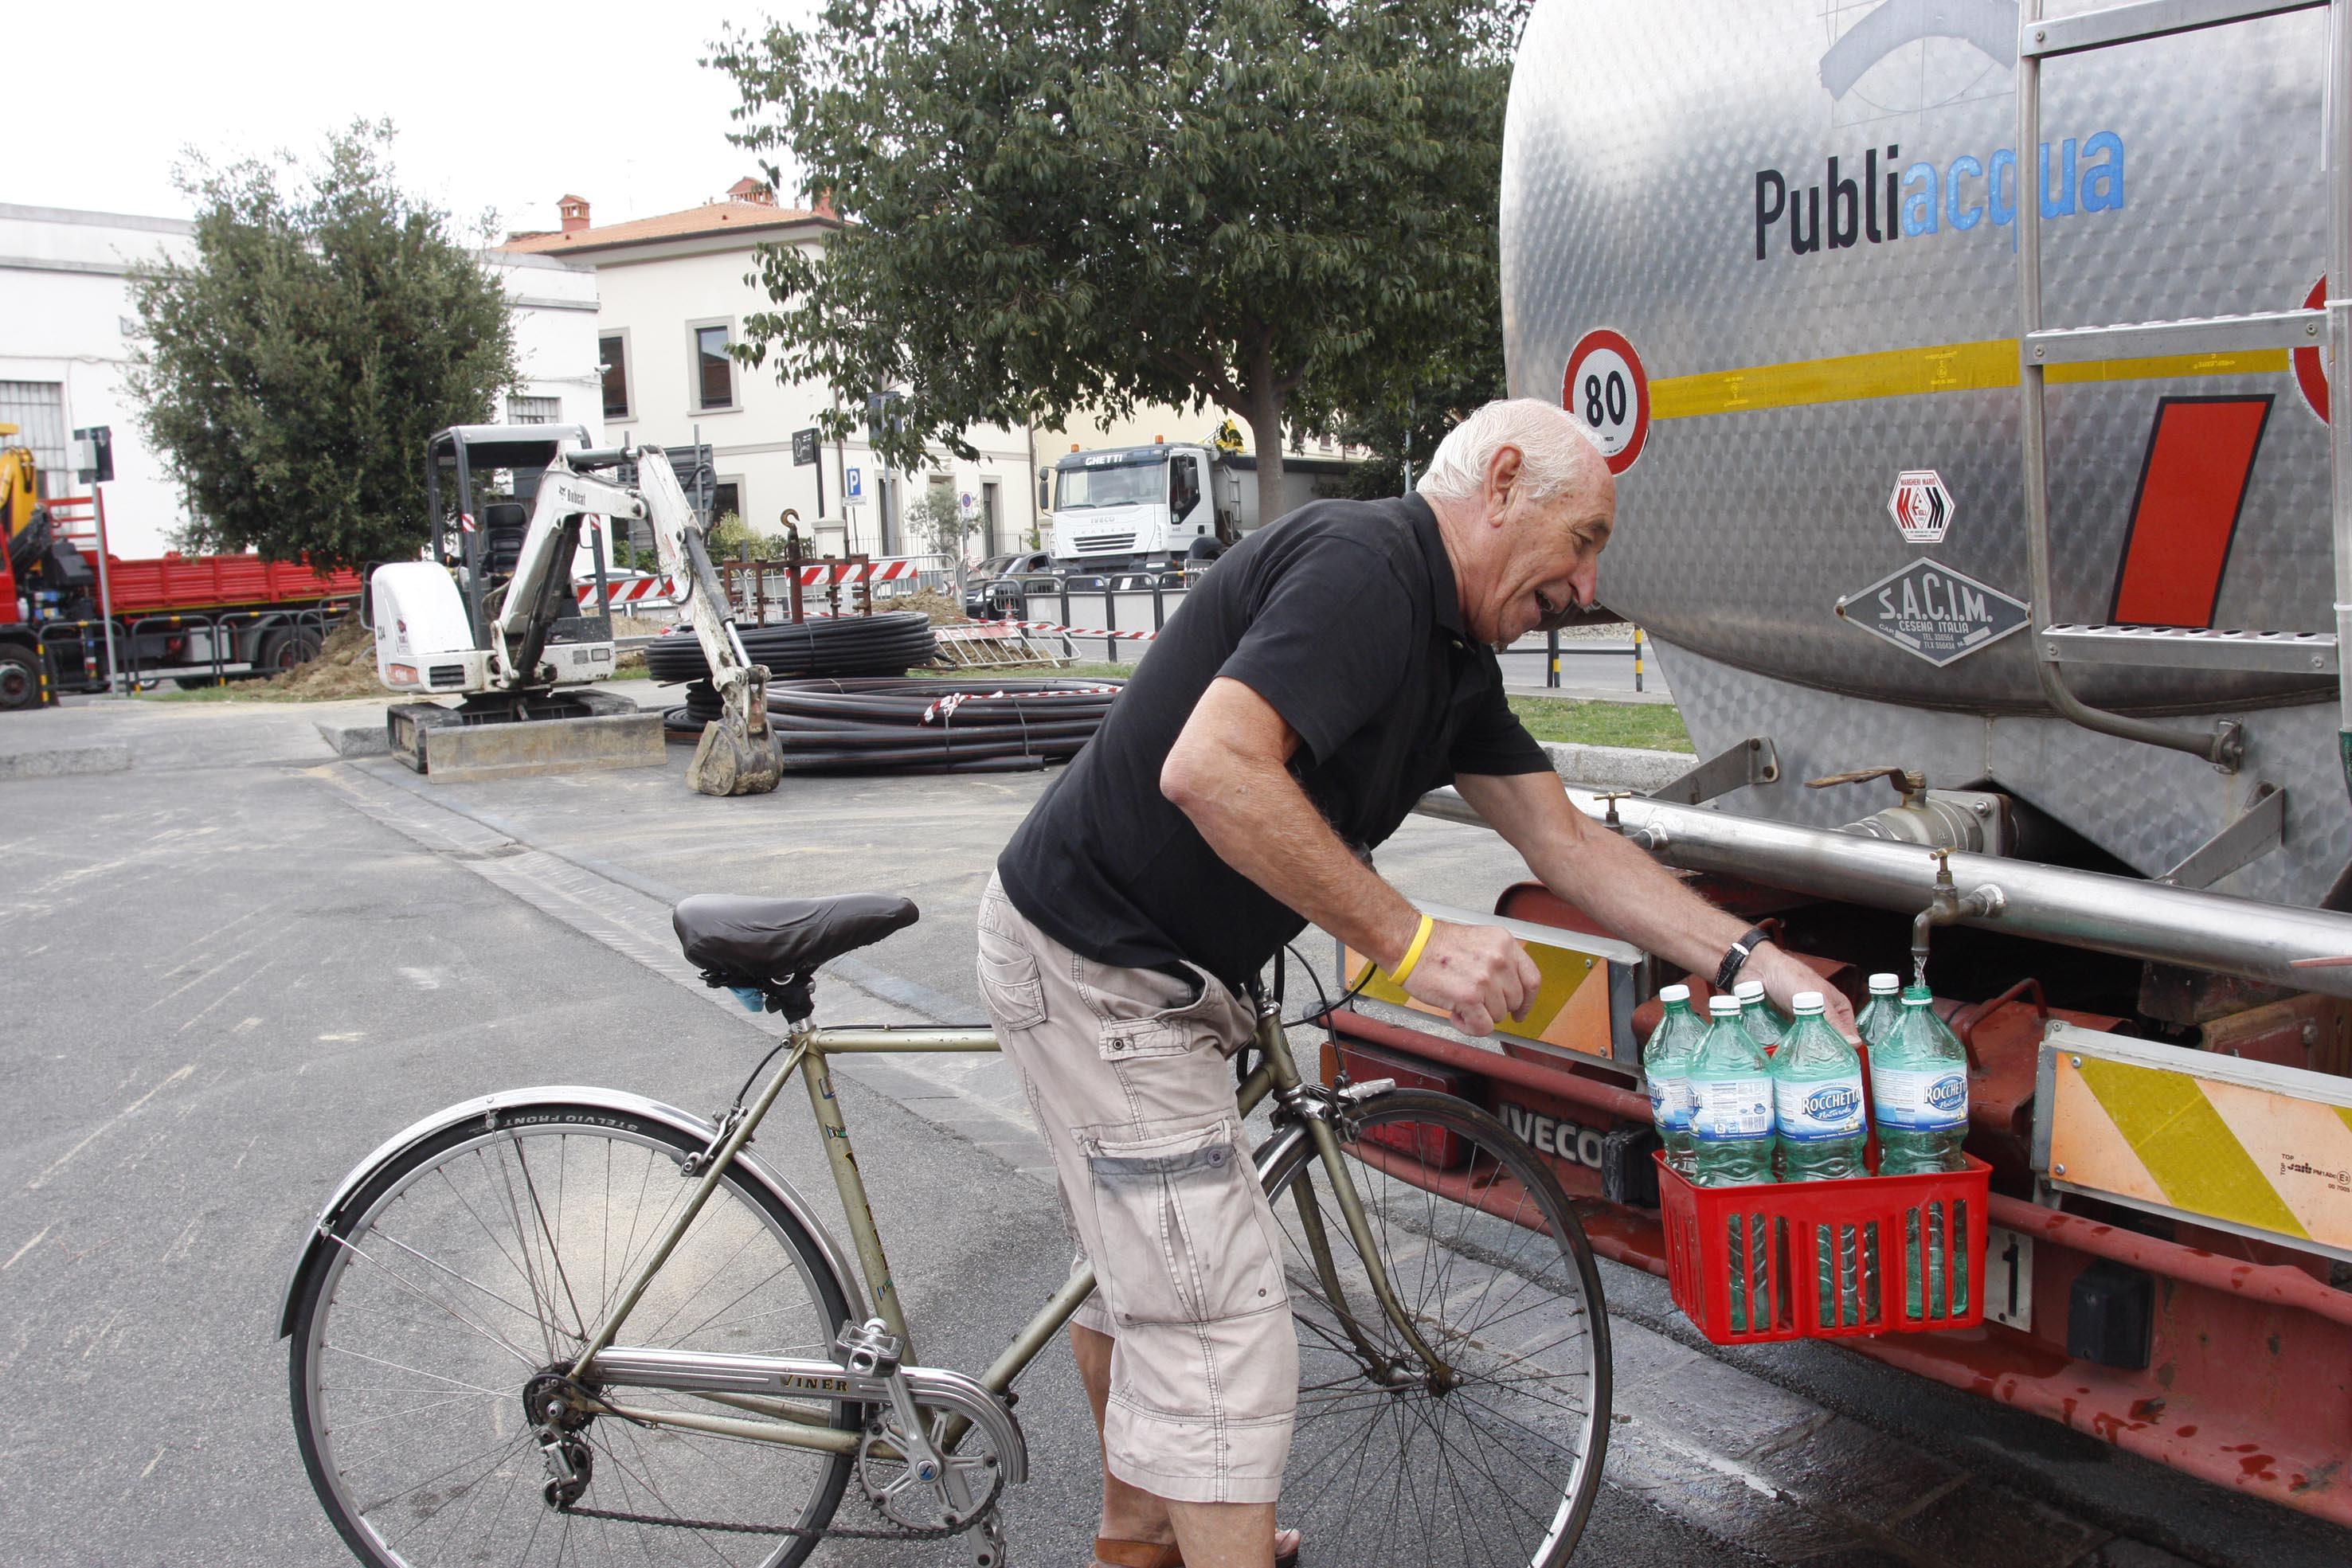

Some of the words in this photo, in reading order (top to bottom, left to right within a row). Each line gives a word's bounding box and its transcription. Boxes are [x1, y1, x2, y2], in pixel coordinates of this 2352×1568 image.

[1755, 131, 2124, 261] Publiacqua
[1585, 370, 1626, 428] 80
[1085, 454, 1123, 466] GHETTI
[849, 471, 859, 494] P
[567, 489, 586, 506] Bobcat
[1878, 573, 1994, 623] S.A.C.I.M.
[1899, 620, 1934, 632] CESENA
[1938, 621, 1970, 634] ITALIA
[1801, 1087, 1862, 1115] ROCCHETTA
[503, 1115, 560, 1128] FRONT
[565, 1115, 640, 1132] STELVIO
[1499, 1103, 1603, 1169] IVECO
[780, 1374, 848, 1392] VINER
